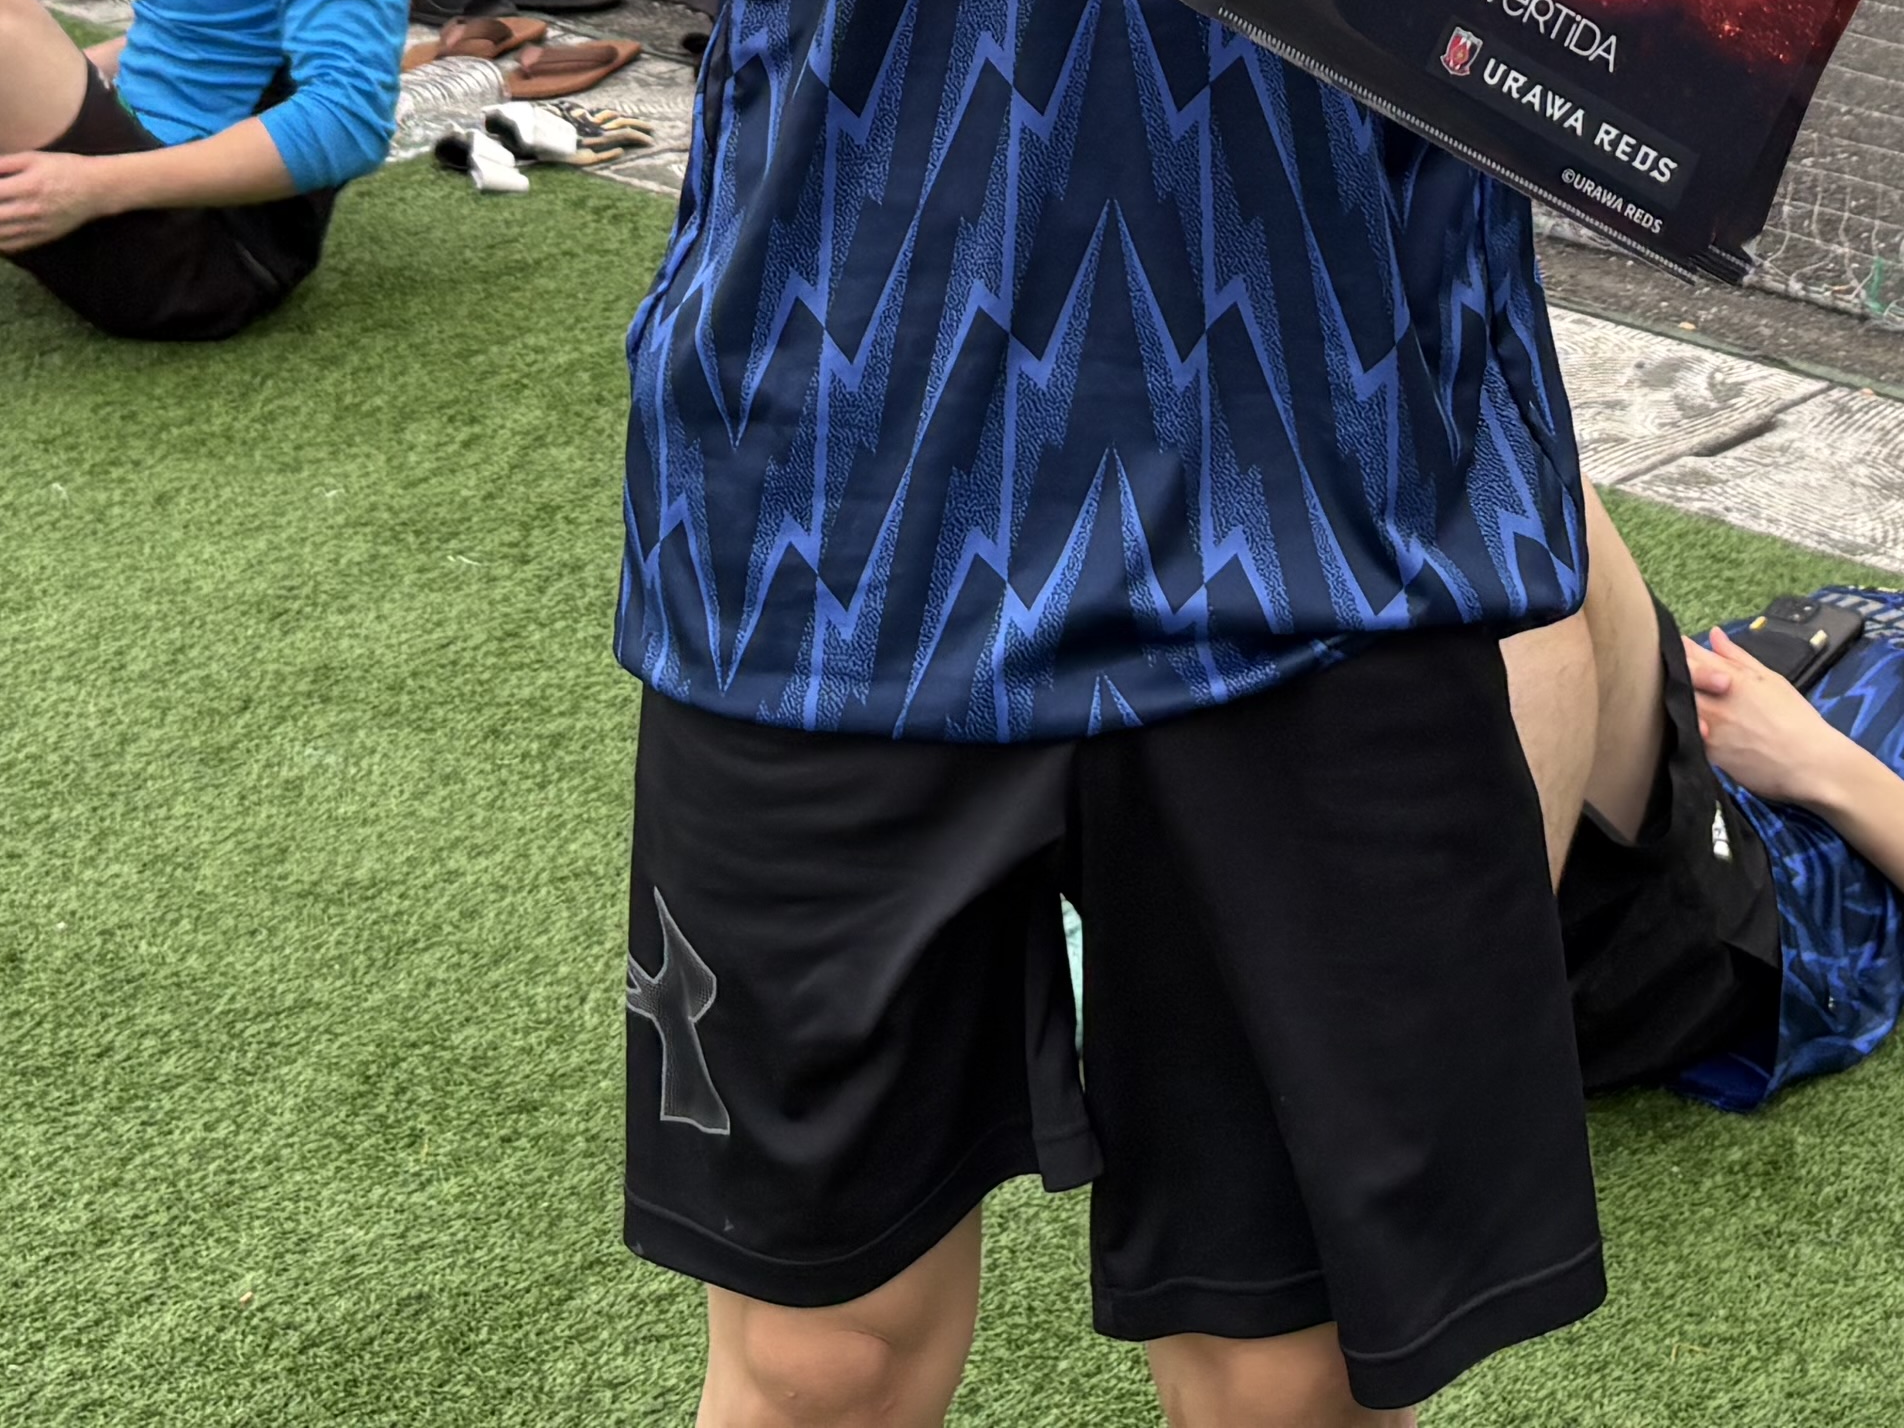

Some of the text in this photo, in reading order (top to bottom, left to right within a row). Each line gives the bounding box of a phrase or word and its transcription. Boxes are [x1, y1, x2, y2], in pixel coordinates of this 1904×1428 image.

[1482, 57, 1679, 185] URAWA REDS
[1623, 196, 1665, 235] REDS
